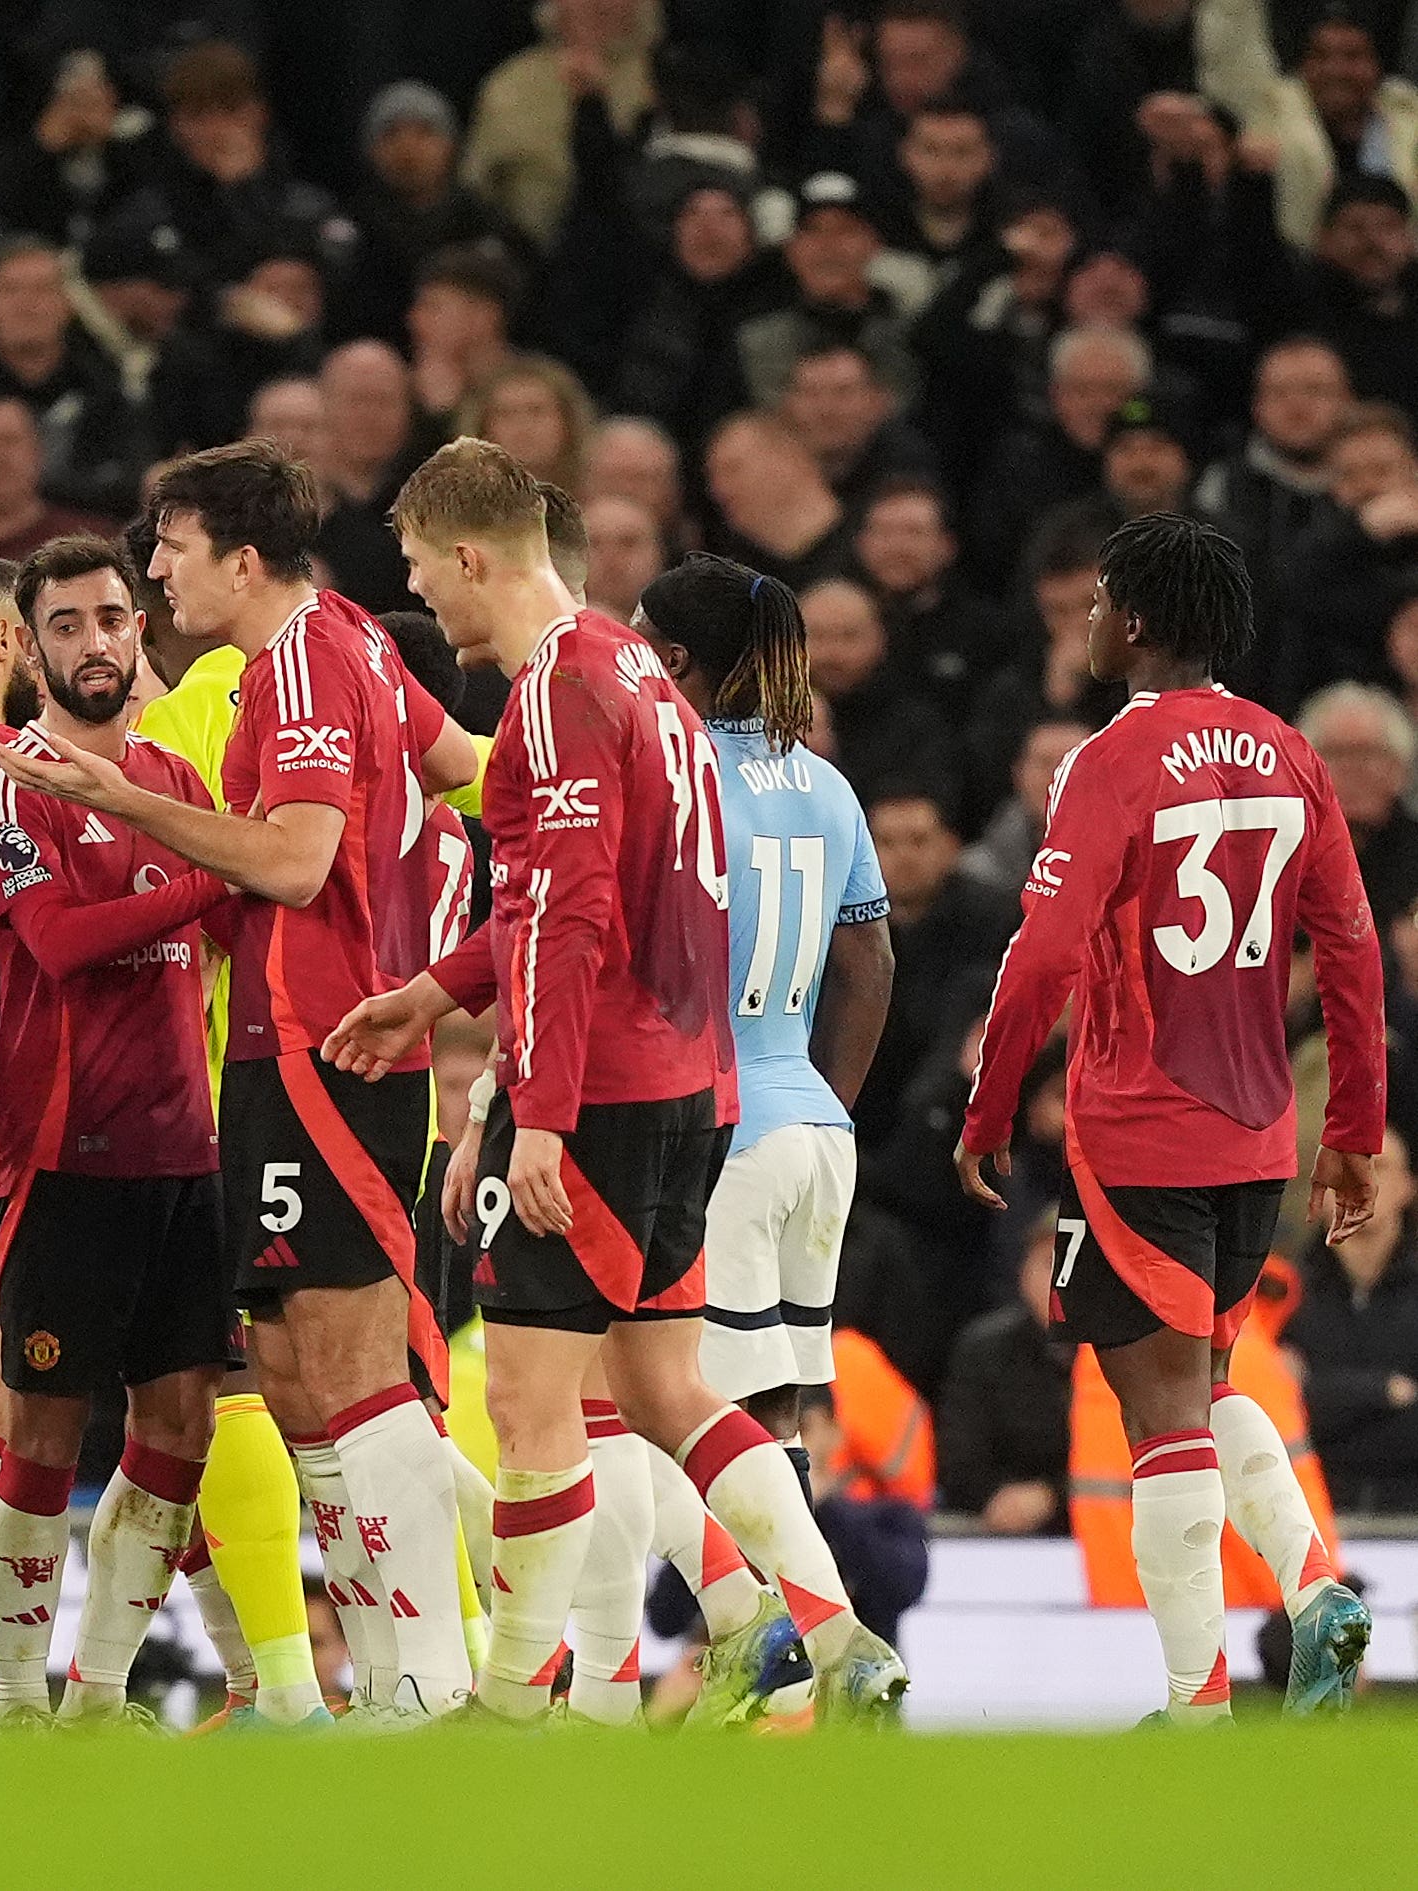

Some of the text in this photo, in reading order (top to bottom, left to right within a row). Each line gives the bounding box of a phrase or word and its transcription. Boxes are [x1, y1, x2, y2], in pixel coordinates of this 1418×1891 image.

[276, 725, 352, 764] DXC
[276, 758, 351, 776] TECHNOLOGY
[737, 757, 813, 795] DOKU
[1161, 728, 1277, 785] MAINOO
[2, 866, 46, 889] No room
[1152, 796, 1305, 977] 37
[737, 834, 826, 1018] 11
[259, 1162, 303, 1233] 5
[475, 1175, 511, 1250] 9
[1055, 1217, 1087, 1288] 7
